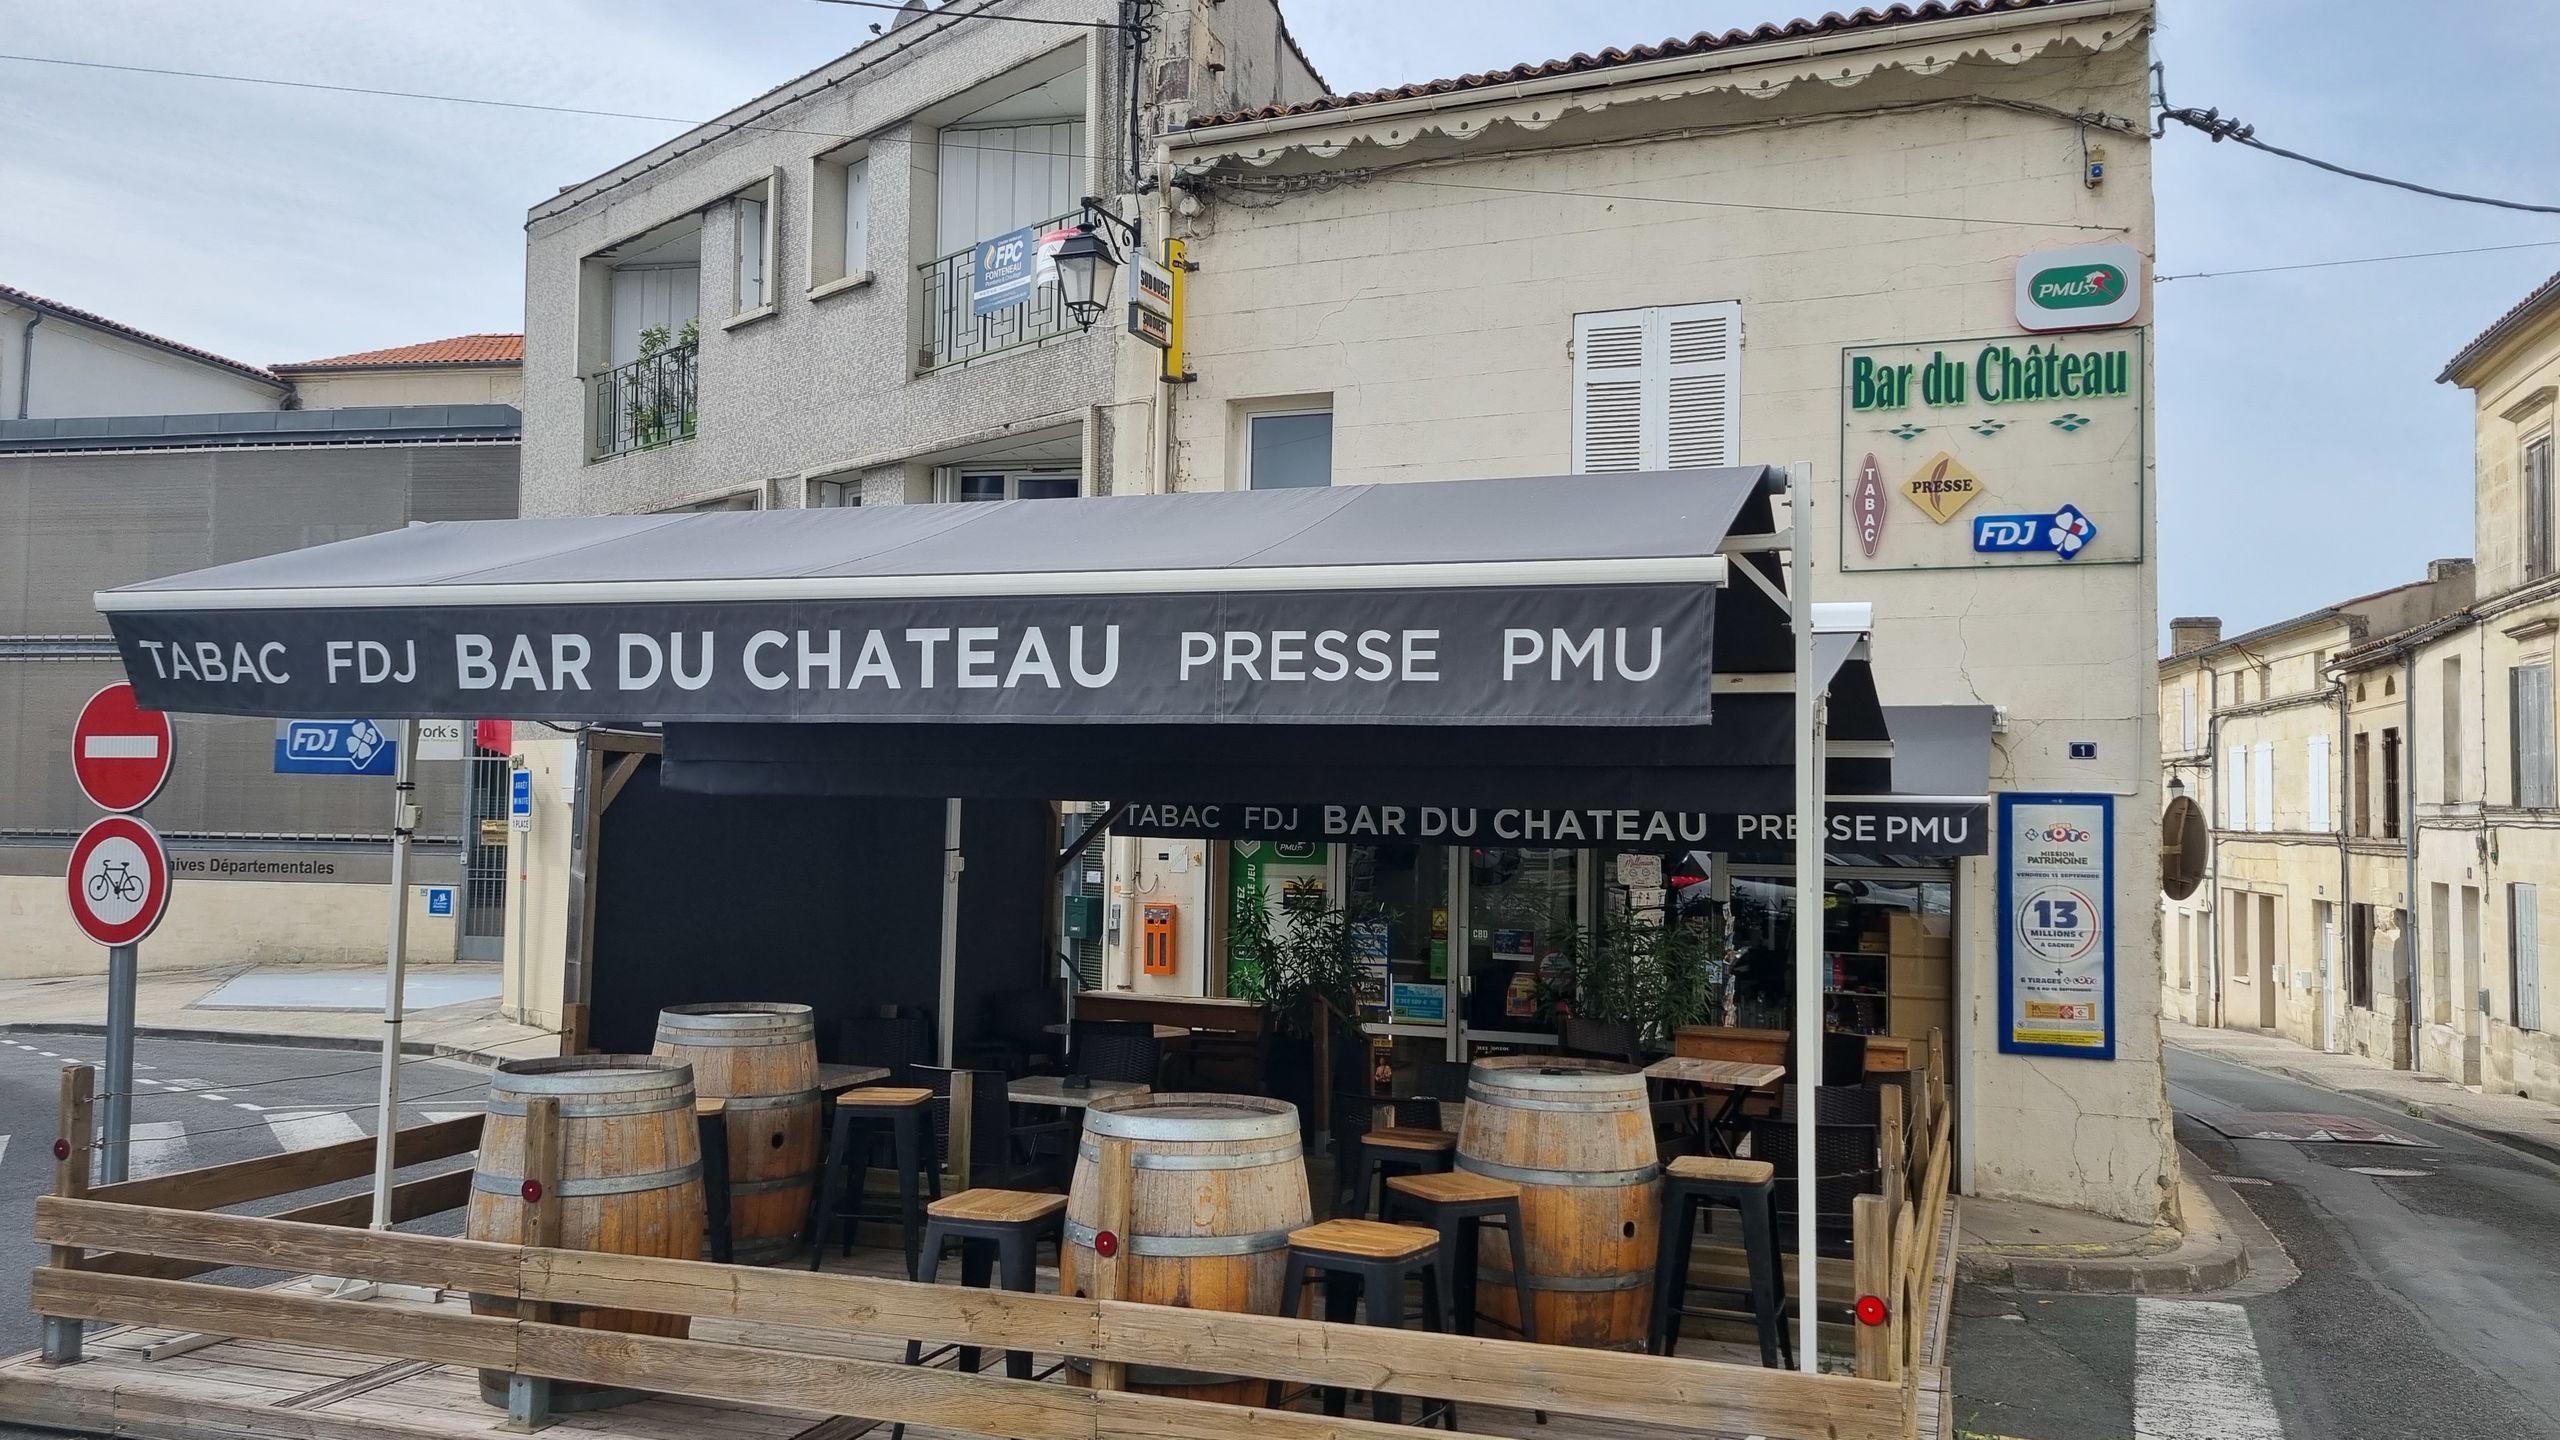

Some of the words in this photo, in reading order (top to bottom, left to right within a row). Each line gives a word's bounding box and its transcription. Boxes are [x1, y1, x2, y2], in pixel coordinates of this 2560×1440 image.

[995, 240, 1024, 268] FPC
[985, 261, 1022, 280] FONTENEAU
[1141, 270, 1152, 290] SUD
[1153, 277, 1170, 300] OUEST
[2039, 281, 2084, 298] PMU
[1143, 312, 1152, 327] SUD
[1152, 317, 1167, 334] OUEST
[1852, 356, 1913, 410] Bar
[1923, 351, 1967, 407] du
[1976, 343, 2128, 403] Château
[1912, 479, 1973, 493] PRESSE
[1864, 468, 1876, 542] TABAC
[1978, 521, 2037, 546] FDJ
[139, 640, 290, 685] TABAC
[327, 640, 417, 684] FDJ
[455, 634, 592, 691] BAR
[618, 632, 713, 691] DU
[743, 624, 1119, 690] CHATEAU
[1180, 629, 1440, 682] PRESSE
[1503, 627, 1662, 682] PMU
[292, 728, 338, 752] FDJ
[1127, 803, 1220, 828] TABAC
[1244, 806, 1298, 831] FDJ
[1324, 804, 1406, 836] BAR
[1420, 807, 1477, 837] DU
[1493, 808, 1707, 843] CHATEAU
[1738, 813, 1876, 842] PRESE
[1886, 815, 1968, 844] PMU
[2042, 827, 2090, 843] LOTO
[1280, 843, 1298, 851] PMU
[210, 858, 335, 876] Départementales
[2027, 856, 2088, 865] PATRIMOINE
[1247, 864, 1256, 882] JEU
[2034, 900, 2078, 928] 13
[1473, 929, 1489, 938] CBD
[2031, 930, 2076, 938] MILLIONS
